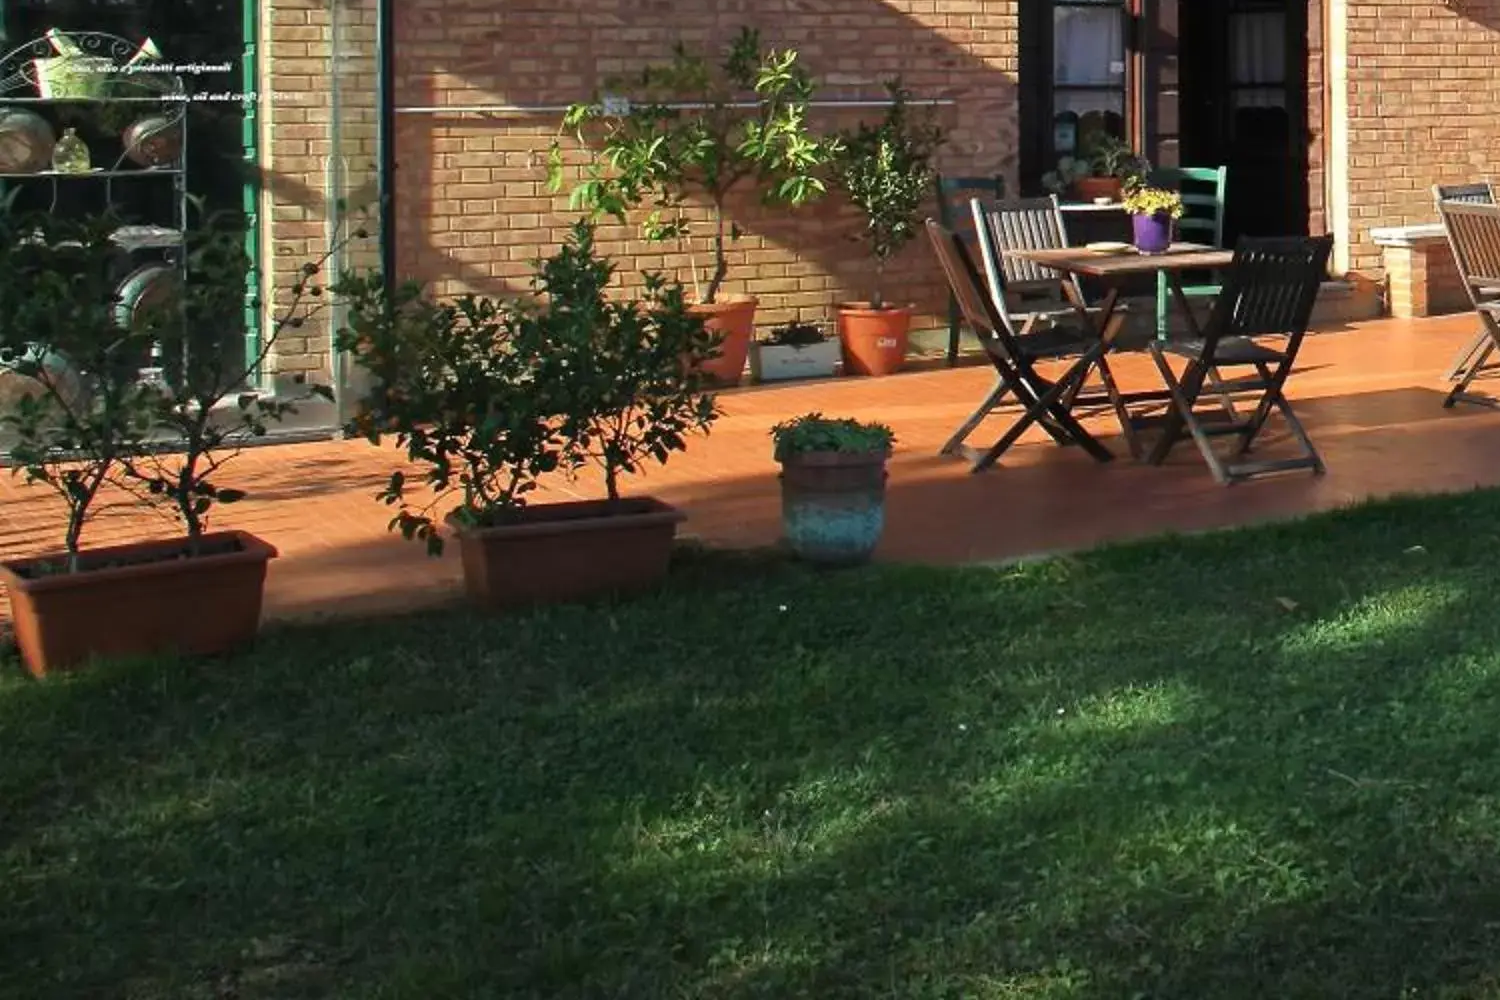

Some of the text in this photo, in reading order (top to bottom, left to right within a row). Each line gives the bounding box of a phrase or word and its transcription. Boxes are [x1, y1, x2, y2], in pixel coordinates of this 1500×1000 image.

[126, 63, 174, 75] prodotti
[175, 62, 233, 75] artigianali
[193, 91, 208, 101] oil
[209, 91, 231, 101] and
